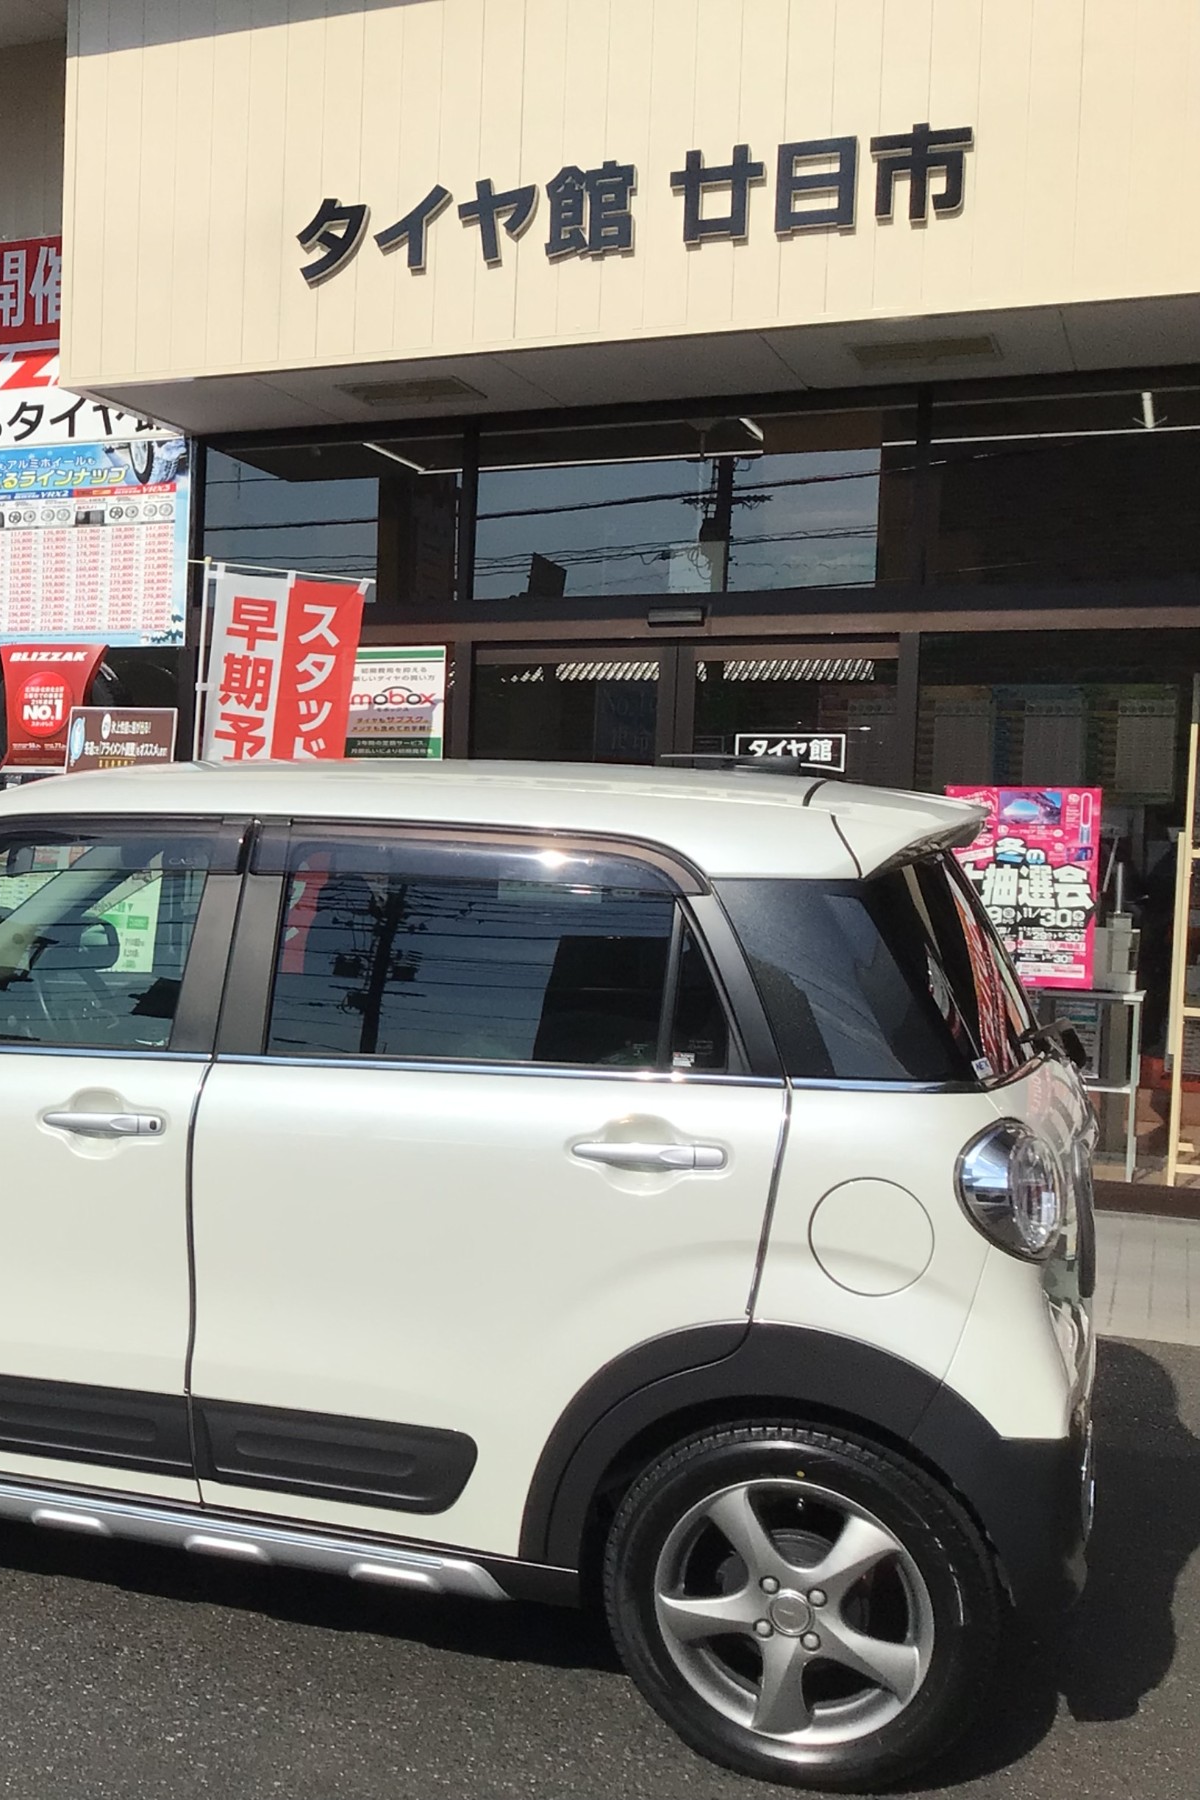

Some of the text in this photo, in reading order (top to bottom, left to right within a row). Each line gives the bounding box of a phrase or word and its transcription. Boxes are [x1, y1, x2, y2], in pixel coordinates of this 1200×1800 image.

[296, 123, 974, 287] タイヤ館 廿日市
[9, 651, 89, 662] BLIZZAK
[351, 689, 437, 705] mobox
[22, 699, 64, 721] NO.1
[748, 739, 833, 763] タイヤ館
[995, 837, 1046, 864] 冬の
